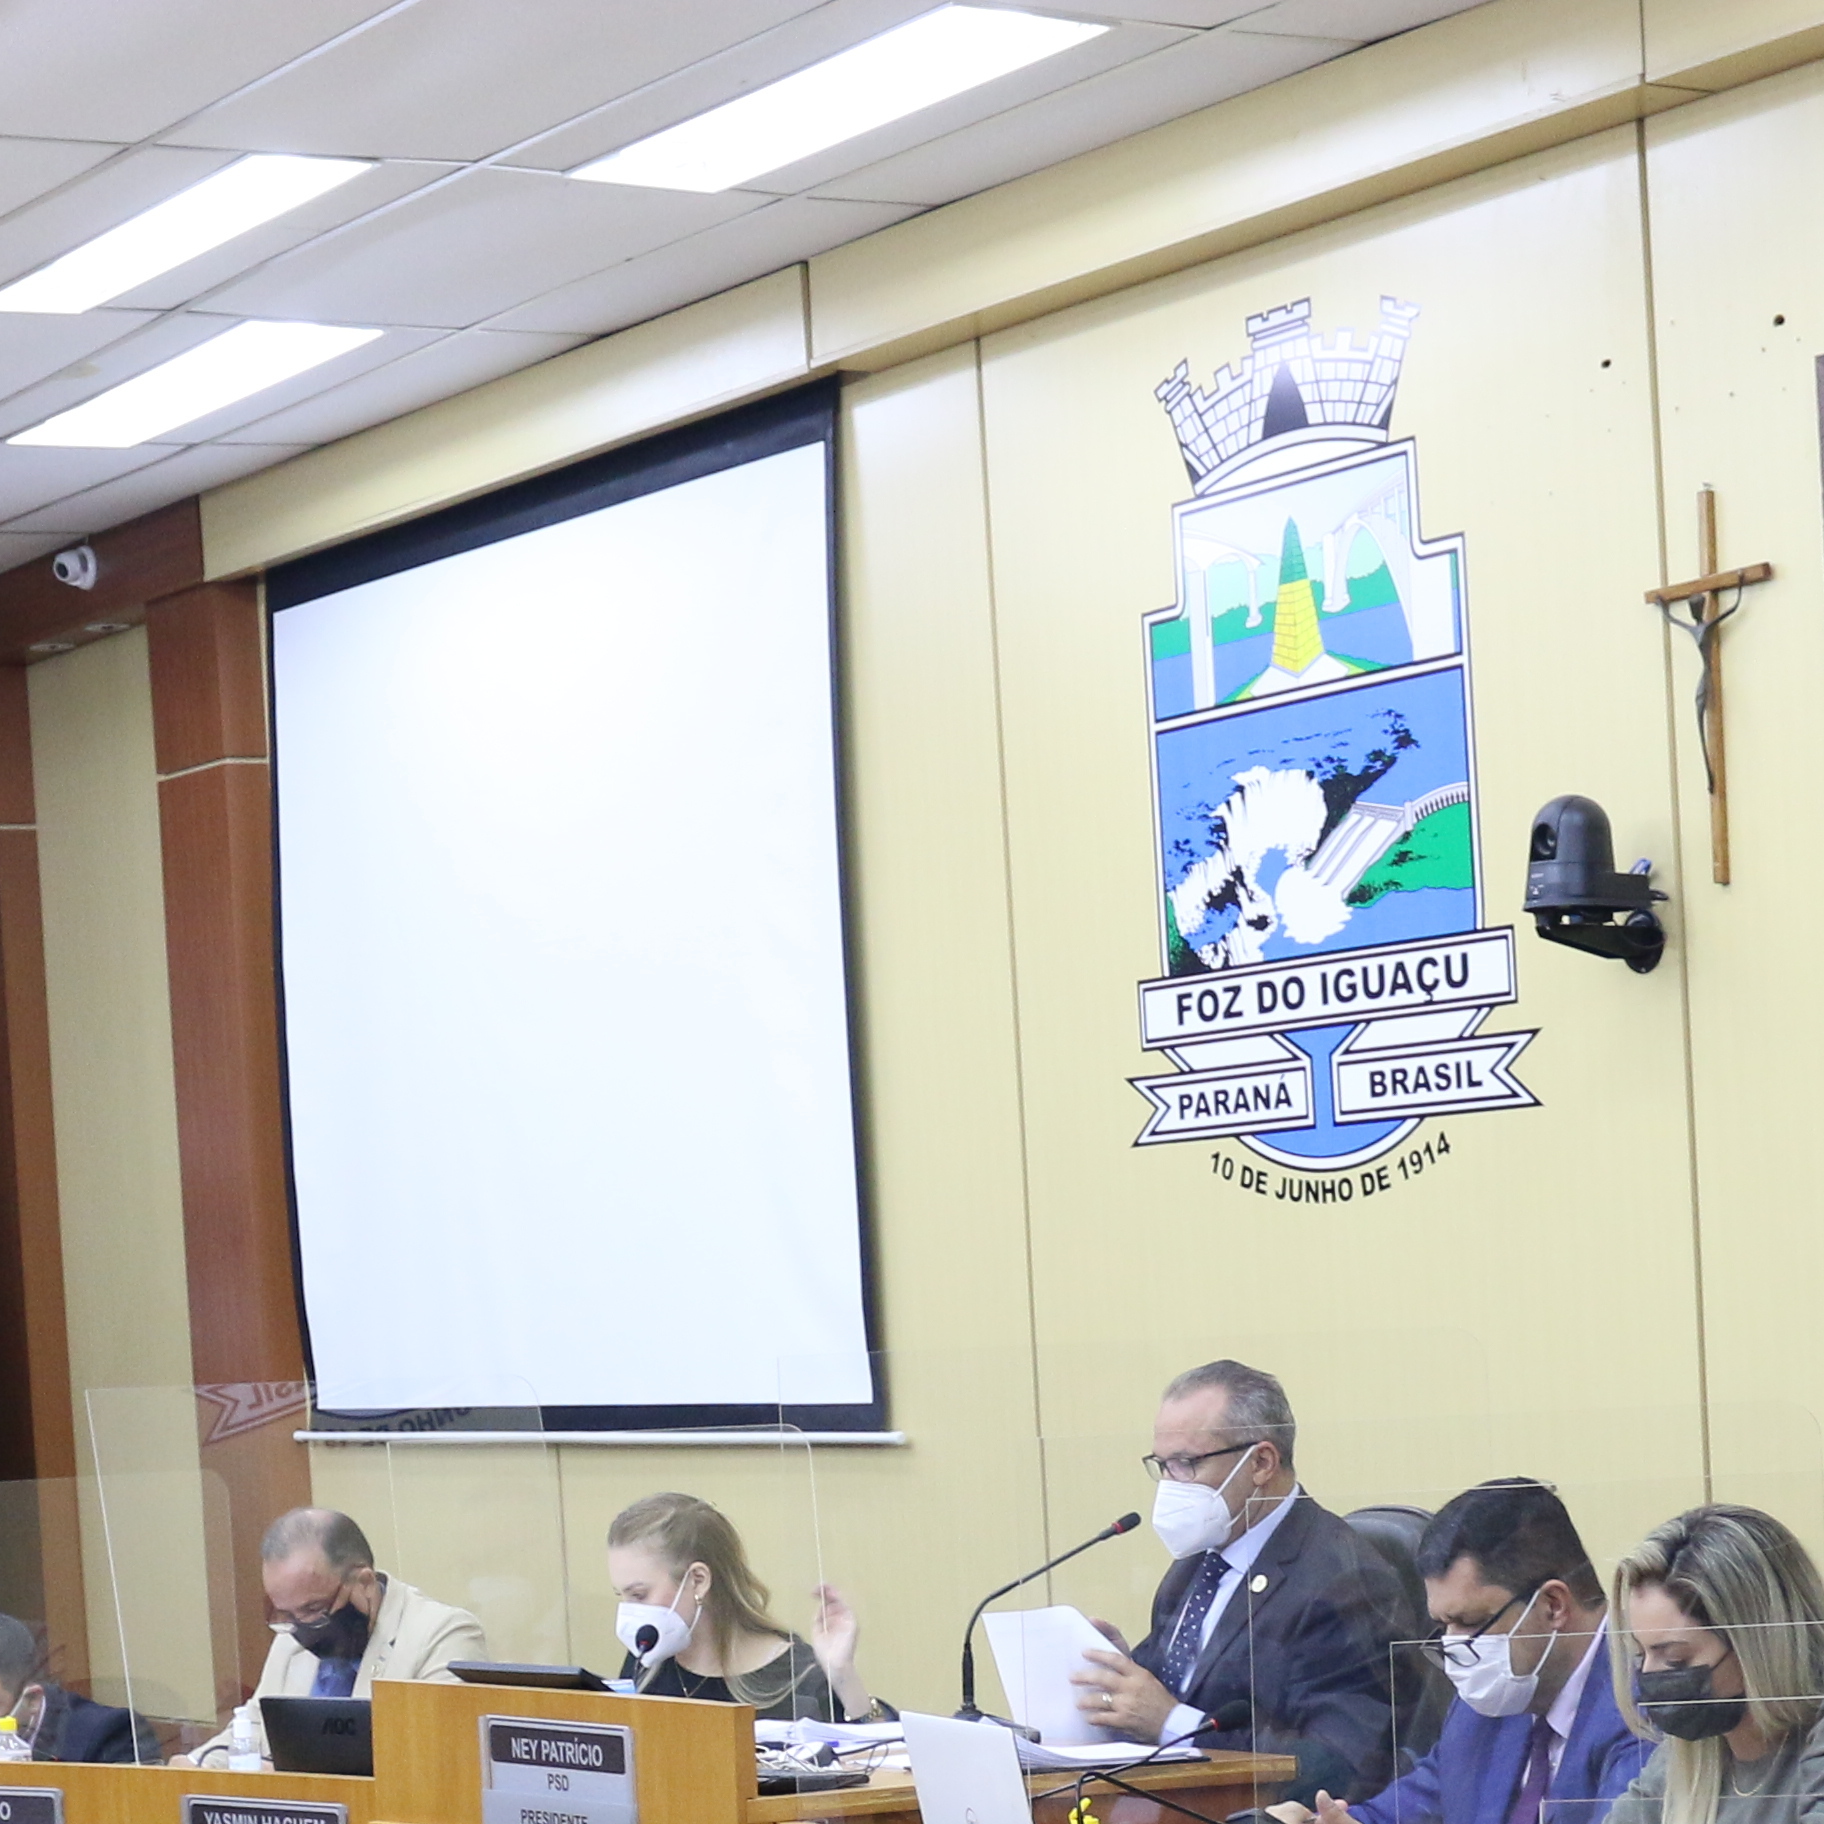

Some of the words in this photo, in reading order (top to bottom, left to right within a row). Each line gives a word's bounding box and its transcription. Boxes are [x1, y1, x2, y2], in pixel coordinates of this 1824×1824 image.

[1177, 985, 1242, 1025] FOZ
[1257, 976, 1305, 1014] DO
[1321, 952, 1469, 1005] IGUAÇU
[1178, 1073, 1292, 1120] PARANÁ
[1370, 1061, 1482, 1098] BRASIL
[1210, 1152, 1234, 1180] 10
[1241, 1164, 1269, 1195] DE
[1276, 1176, 1353, 1203] JUNHO
[1361, 1166, 1391, 1197] DE
[1397, 1131, 1451, 1181] 1914
[511, 1737, 538, 1760] NEY
[541, 1737, 603, 1767] PATRÍCIO
[547, 1773, 570, 1792] PSD
